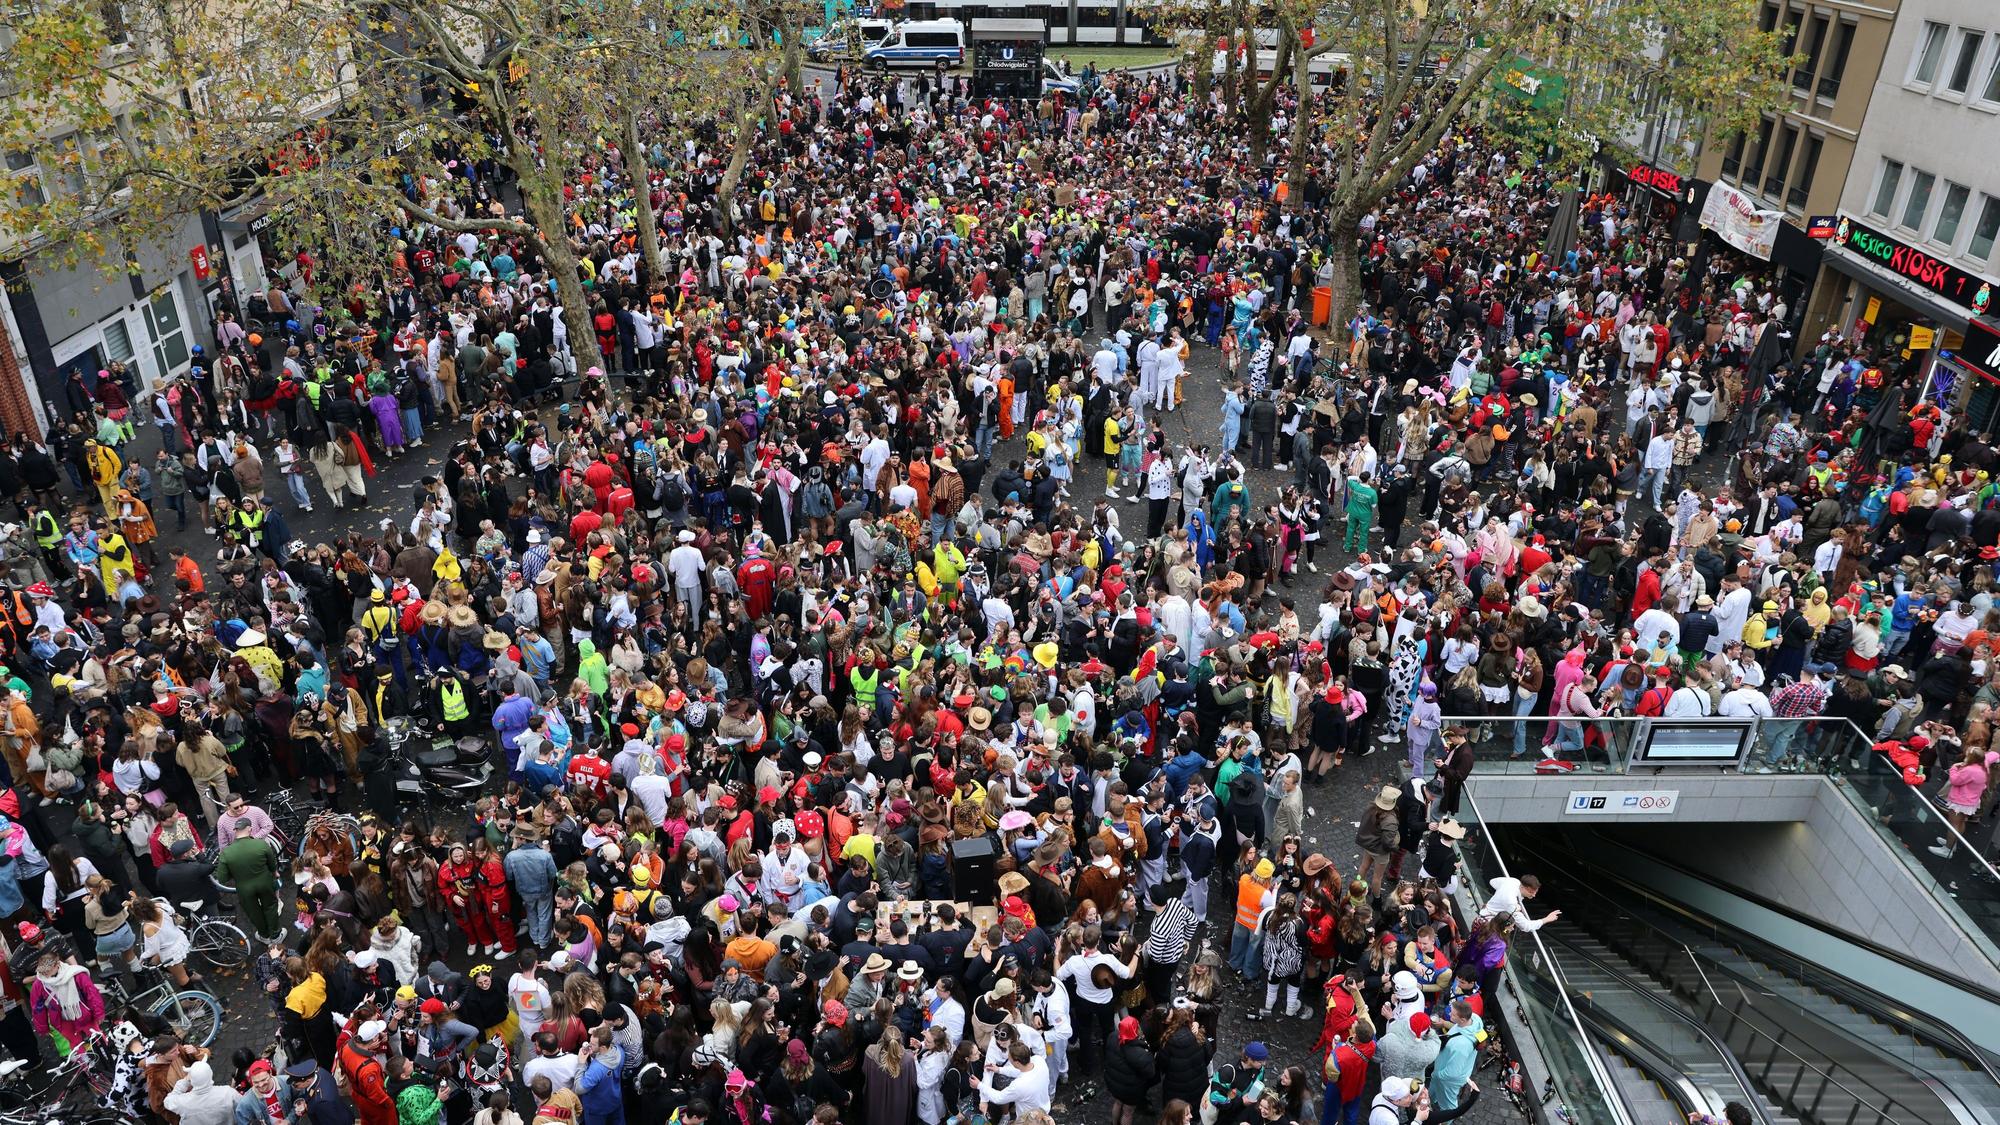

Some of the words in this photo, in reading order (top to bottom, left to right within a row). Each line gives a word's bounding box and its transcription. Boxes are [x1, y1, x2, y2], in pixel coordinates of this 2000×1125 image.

[1003, 48, 1014, 60] U
[987, 61, 1028, 69] Chlodwigplatz
[1816, 218, 1831, 228] sky
[421, 258, 432, 267] 12
[1851, 230, 1893, 261] MEXICO
[1890, 246, 1950, 292] KIOSK
[1575, 797, 1589, 808] U
[1592, 799, 1605, 807] 17
